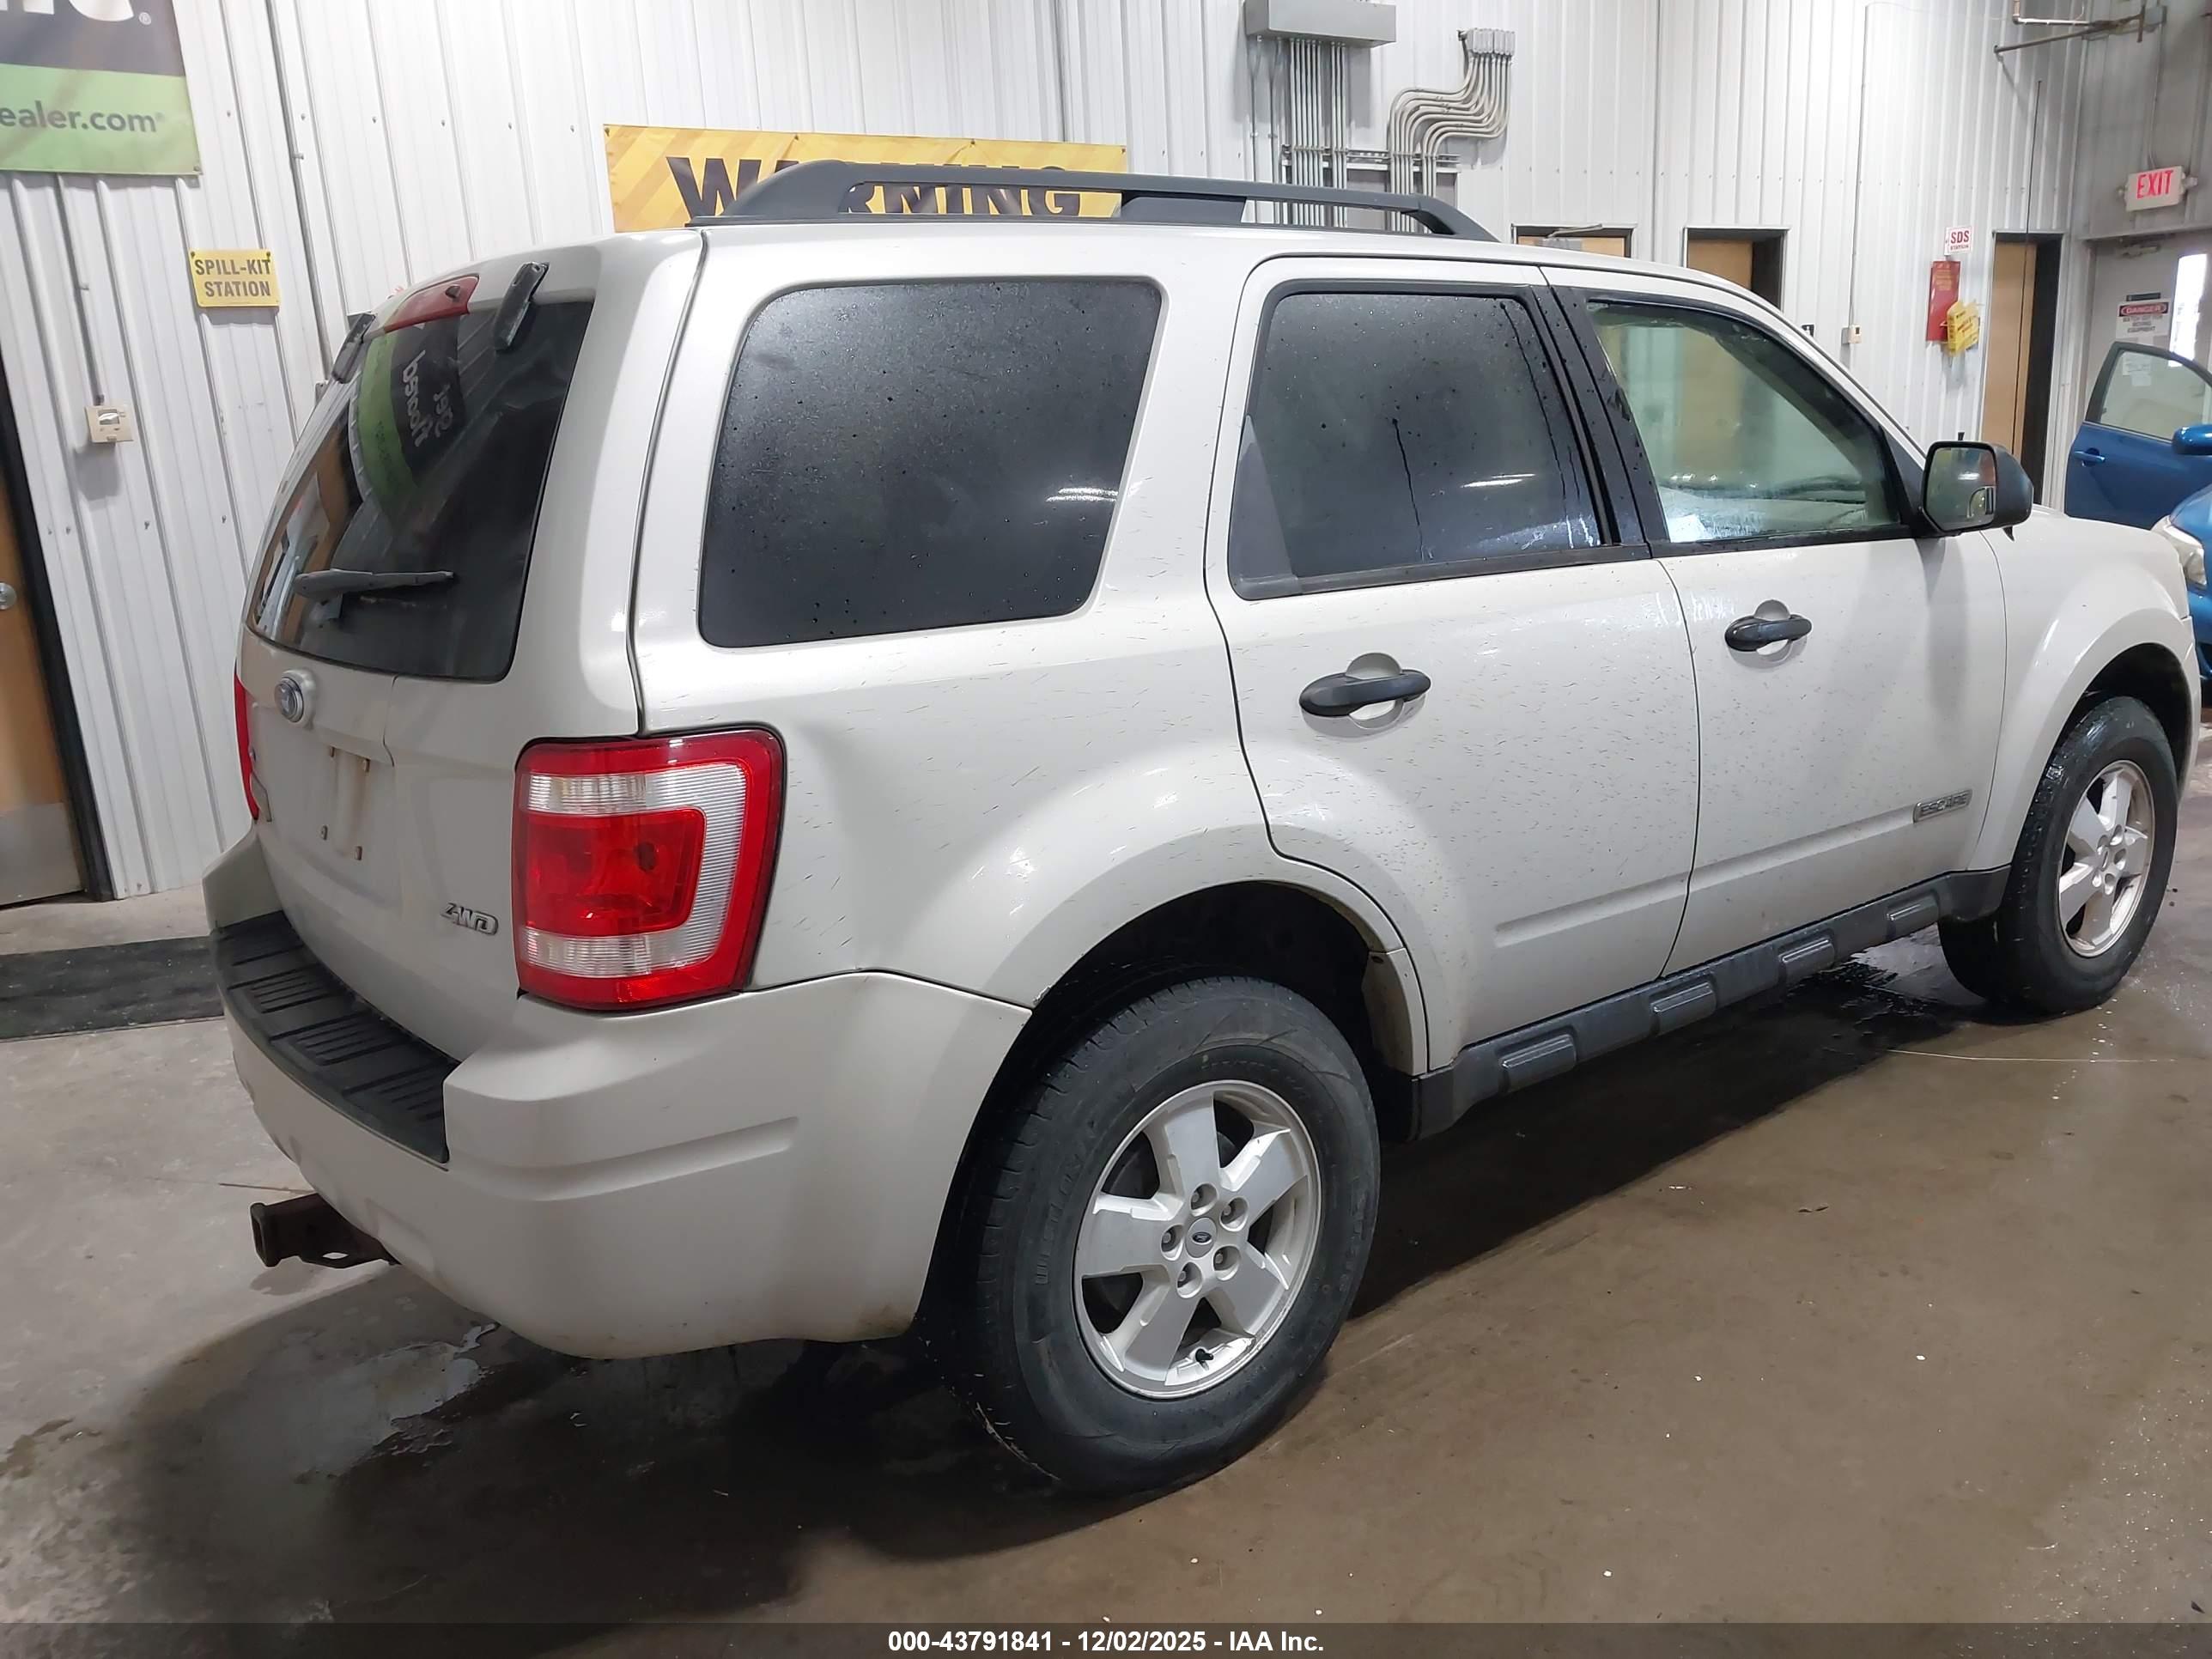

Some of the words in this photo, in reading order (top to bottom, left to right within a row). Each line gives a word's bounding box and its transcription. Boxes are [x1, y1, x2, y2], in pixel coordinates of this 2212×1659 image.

[2137, 170, 2173, 199] EXIT
[1950, 230, 1970, 244] SDS
[195, 258, 270, 276] SPILL-KIT
[204, 281, 270, 298] STATION
